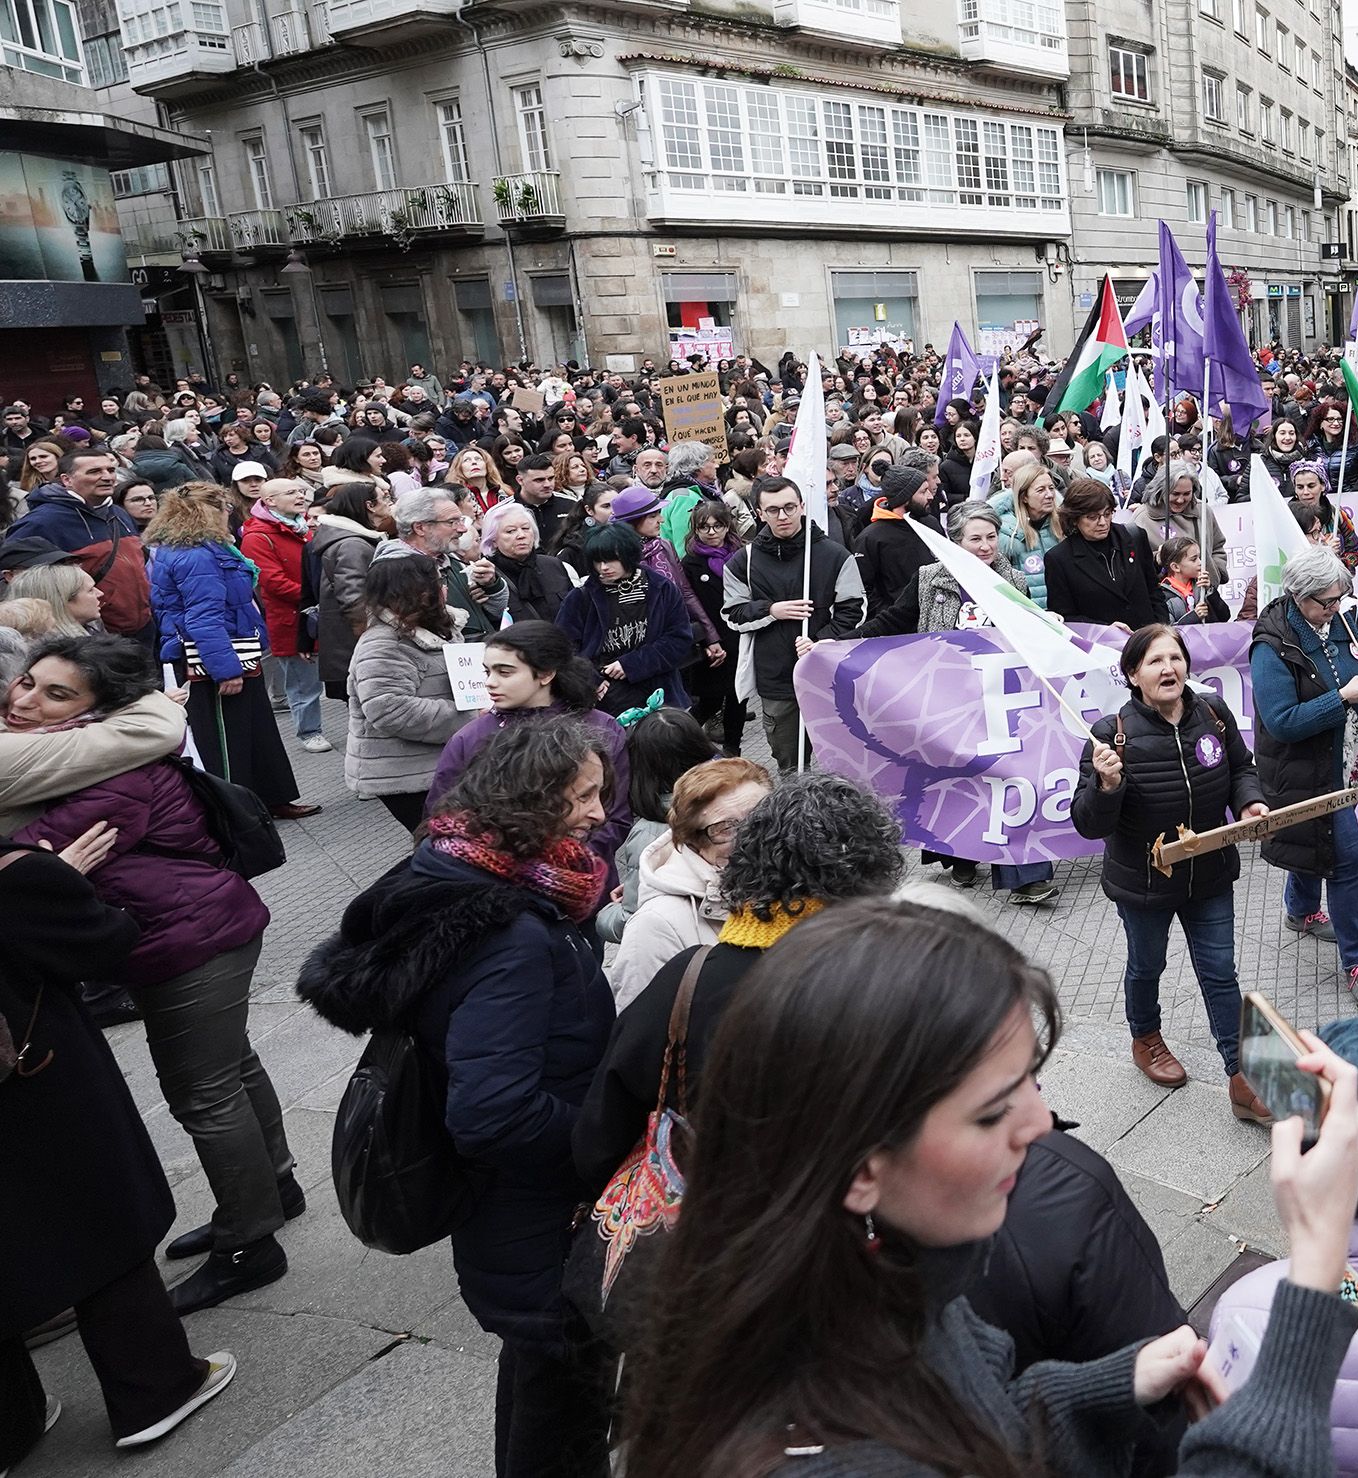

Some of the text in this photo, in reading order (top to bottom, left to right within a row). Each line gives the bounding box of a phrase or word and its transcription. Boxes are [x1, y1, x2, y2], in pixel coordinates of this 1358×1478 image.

[663, 380, 717, 395] EN UN MUNDO
[665, 398, 675, 406] EN
[677, 396, 684, 404] EL
[703, 391, 718, 400] HAY
[694, 426, 717, 435] HACEN
[458, 656, 473, 668] 8M
